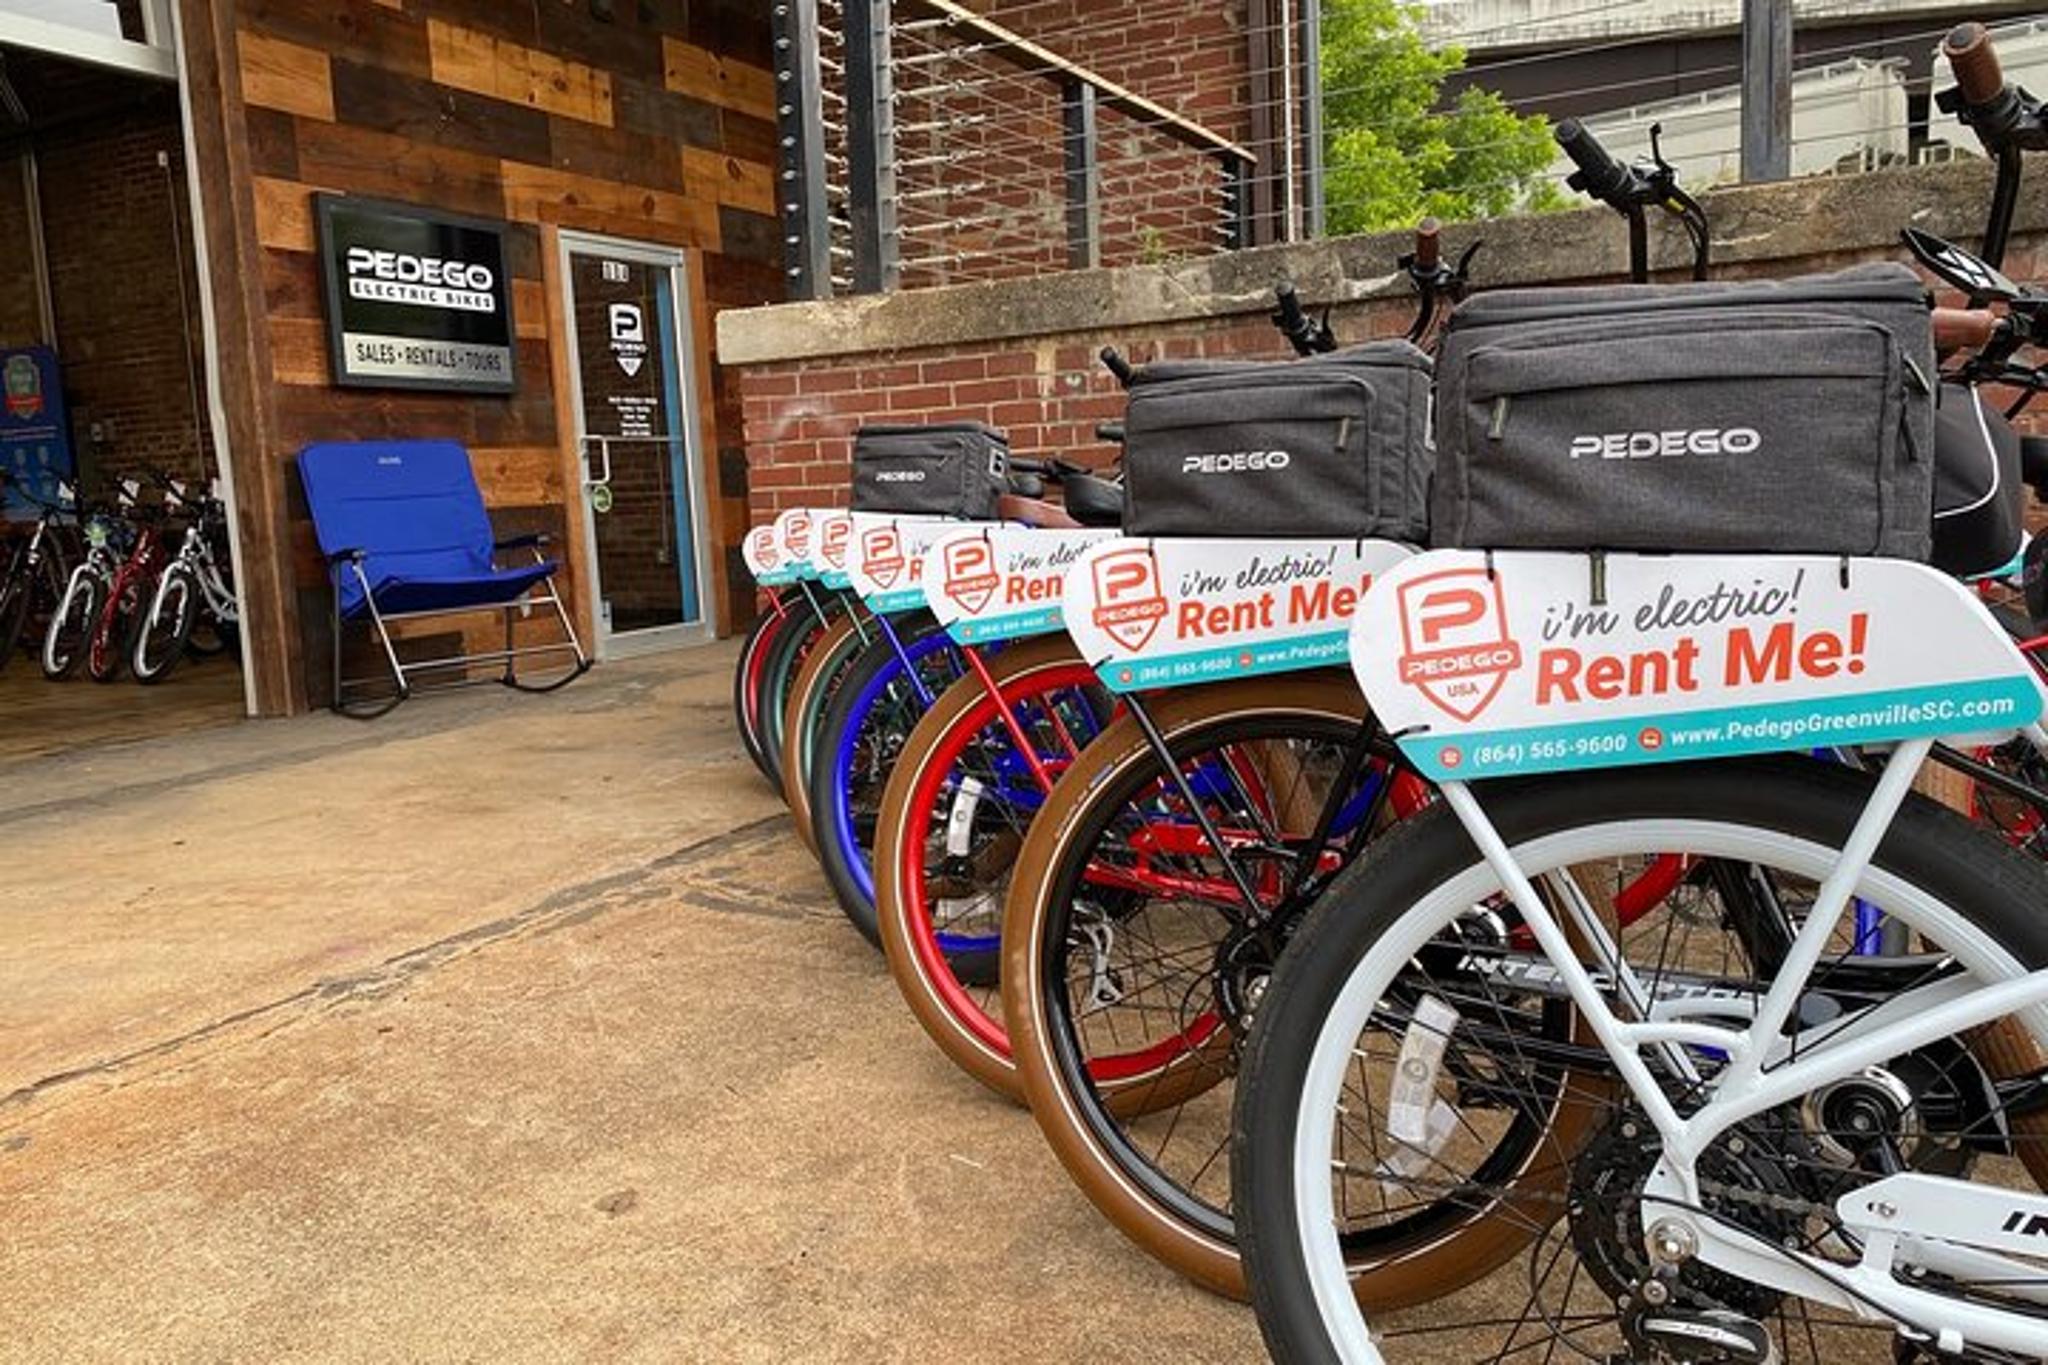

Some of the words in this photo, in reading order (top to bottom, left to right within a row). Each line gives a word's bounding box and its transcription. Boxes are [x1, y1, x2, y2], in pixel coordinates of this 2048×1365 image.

[347, 247, 493, 290] PEDEGO
[353, 281, 438, 303] ELECTRIC
[445, 292, 491, 309] BIKES
[356, 343, 395, 364] SALES
[405, 346, 456, 368] RENTALS
[465, 351, 501, 371] TOURS
[1569, 428, 1761, 459] PEDEGO
[875, 471, 926, 482] PEDEGO
[1182, 451, 1290, 473] PEDEGO
[955, 549, 985, 575] P
[1179, 571, 1227, 598] i'm
[1236, 545, 1338, 590] electric!
[1006, 576, 1063, 604] Ren
[1106, 562, 1148, 599] P
[1097, 602, 1164, 624] PEDEGO
[1176, 592, 1275, 640] Rent
[1420, 588, 1487, 644] P
[1542, 602, 1620, 642] i'm
[1634, 567, 1805, 633] electric!
[1405, 650, 1515, 678] PEDEGO
[1535, 637, 1701, 706] Rent
[1724, 613, 1869, 687] Me!
[1446, 684, 1481, 699] USA
[1472, 744, 1524, 768] (864)
[1530, 733, 1629, 760] 565-9600
[1670, 695, 2015, 746] www.PedegoGreenvilleSC.com
